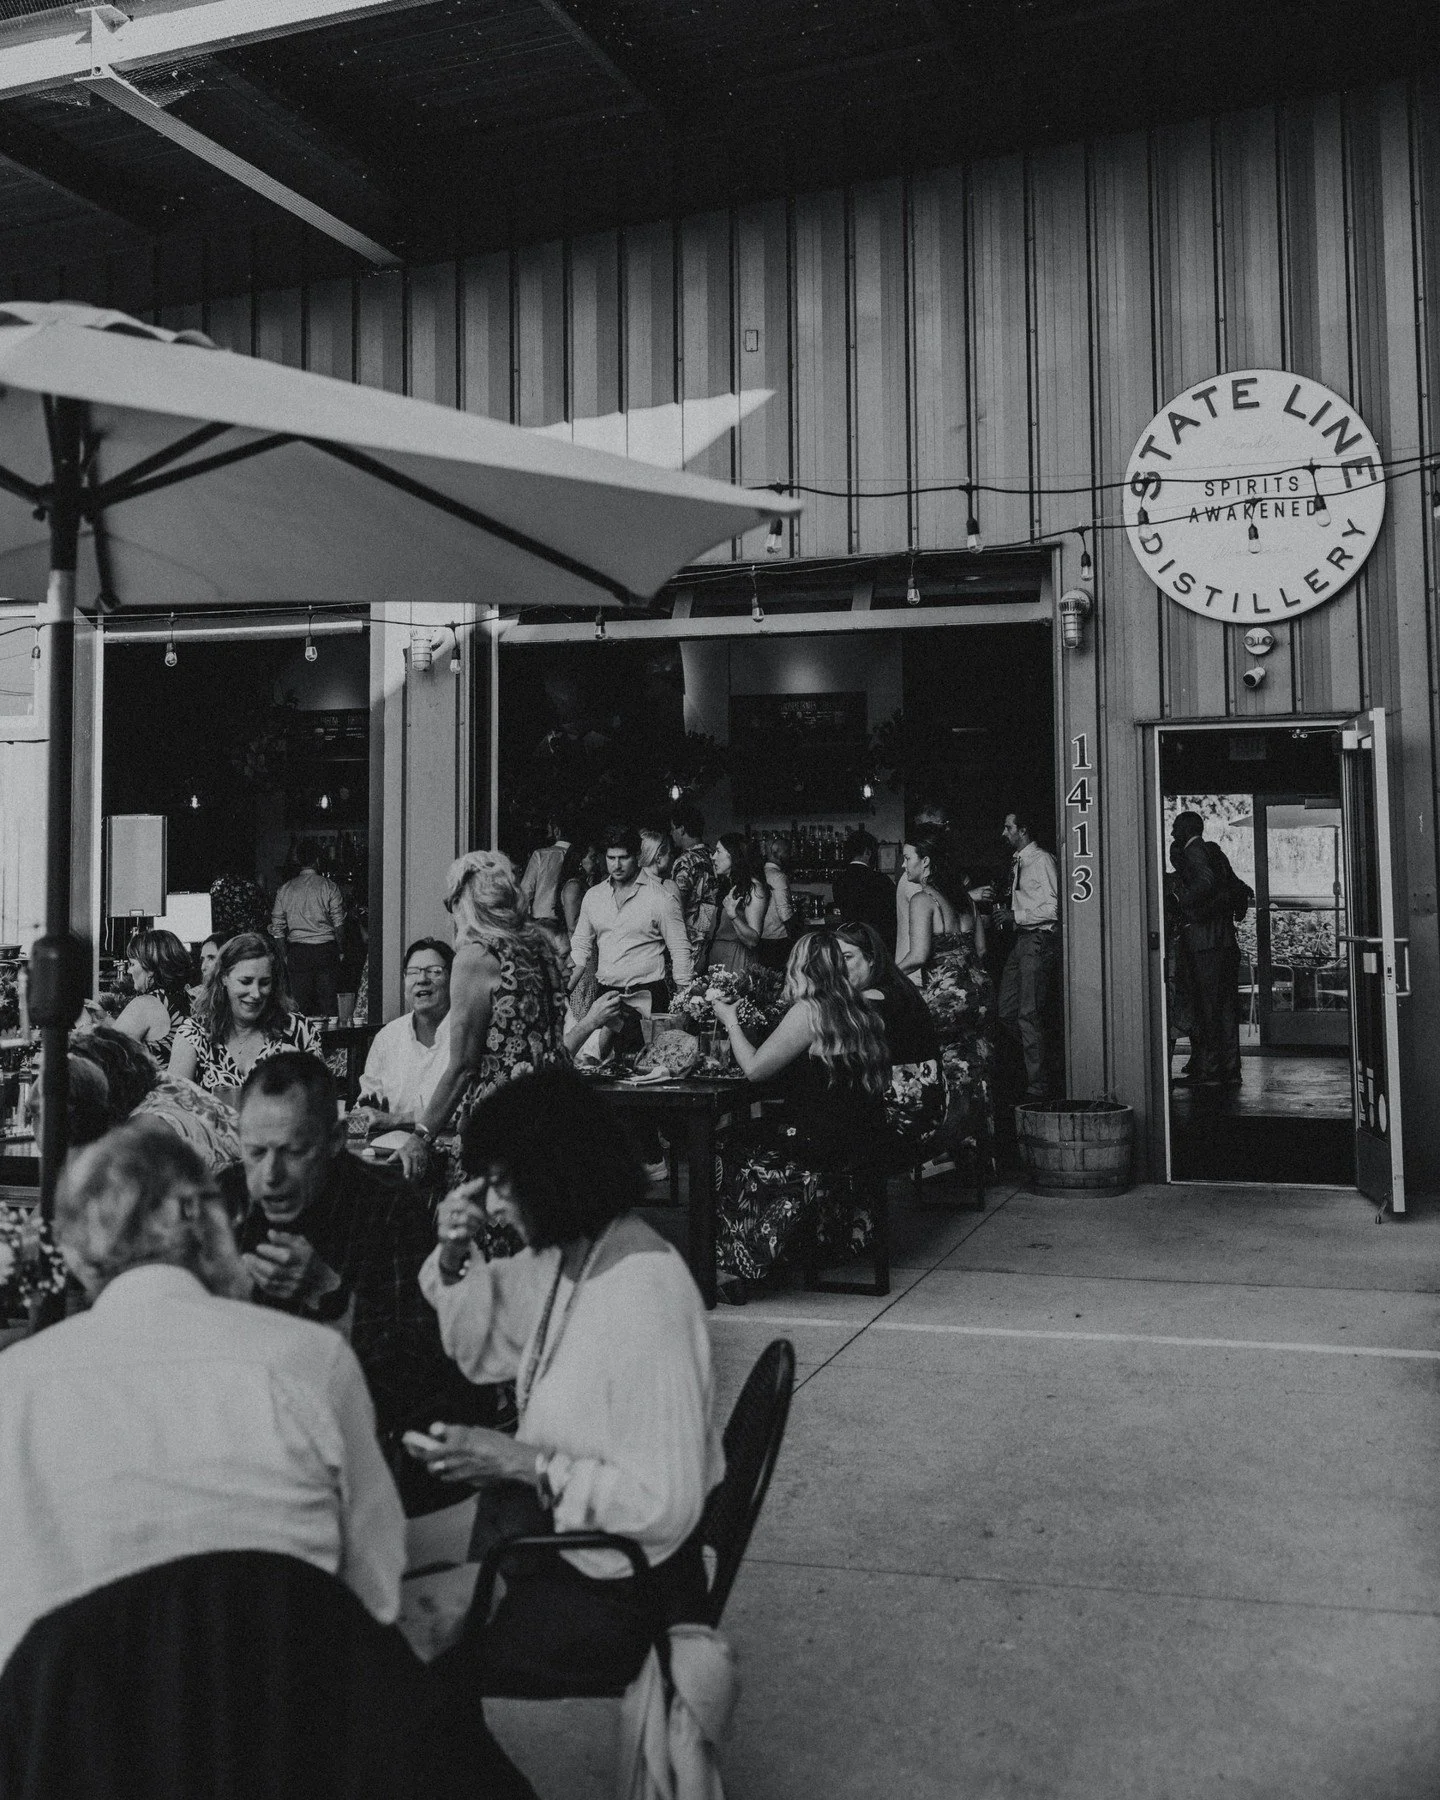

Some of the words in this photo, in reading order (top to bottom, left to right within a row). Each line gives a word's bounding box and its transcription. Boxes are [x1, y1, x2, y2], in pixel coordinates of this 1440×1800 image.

[1130, 377, 1260, 500] STATE
[1283, 384, 1377, 488] LINE
[1204, 476, 1299, 496] SPIRITS
[1189, 500, 1317, 522] AWAKENED
[1141, 518, 1366, 614] DISTILLERY
[1066, 733, 1093, 902] 1413
